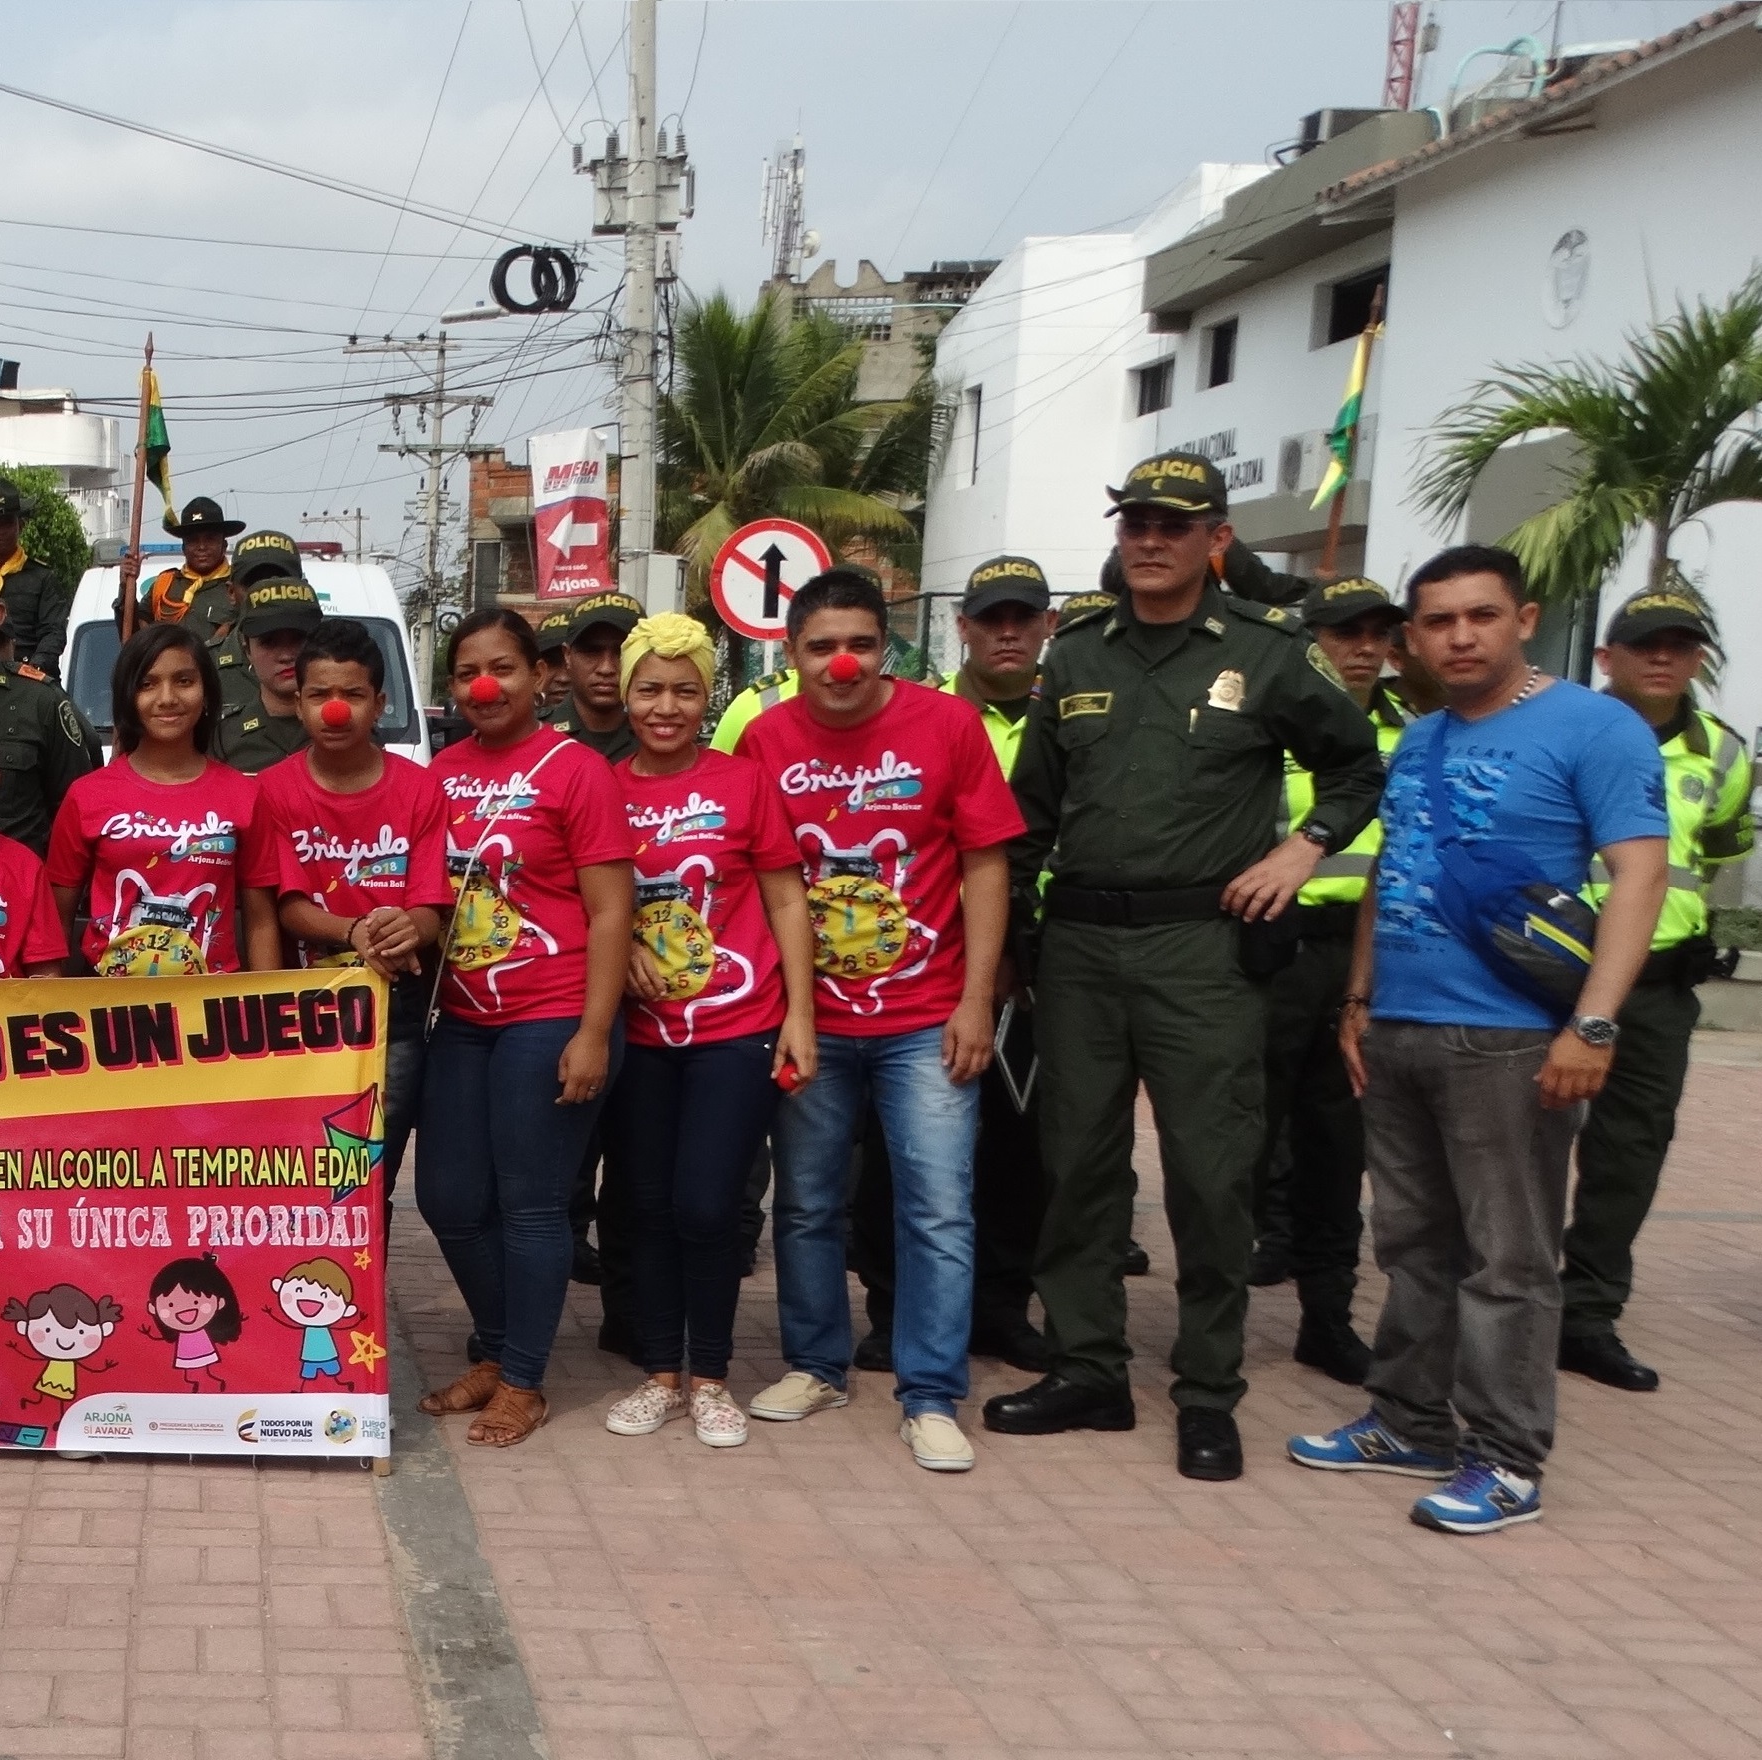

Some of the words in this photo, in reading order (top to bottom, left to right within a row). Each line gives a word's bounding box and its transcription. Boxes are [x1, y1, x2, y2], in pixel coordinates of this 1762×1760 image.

[546, 460, 599, 488] MEGA
[239, 535, 295, 556] POLICIA
[548, 577, 600, 592] Arjona
[973, 562, 1043, 588] POLICIA
[250, 585, 315, 609] POLICIA
[575, 593, 641, 618] POLICIA
[780, 750, 922, 806] Brújula
[147, 934, 170, 952] 12
[7, 1010, 90, 1080] ES
[90, 1002, 183, 1072] UN
[187, 985, 378, 1063] JUEGO
[29, 1147, 144, 1191] ALCOHOL
[150, 1147, 169, 1189] A
[172, 1145, 309, 1189] TEMPRANA
[314, 1145, 371, 1188] EDAD
[17, 1206, 54, 1250] SU
[68, 1197, 172, 1250] ÚNICA
[187, 1204, 370, 1249] PRIORIDAD
[84, 1412, 132, 1423] ARJONA
[260, 1419, 285, 1427] TODOS
[285, 1420, 301, 1428] POR
[302, 1420, 313, 1428] UN
[94, 1426, 134, 1436] AVANZA
[260, 1428, 291, 1437] NUEVO
[292, 1428, 313, 1438] PAÍS
